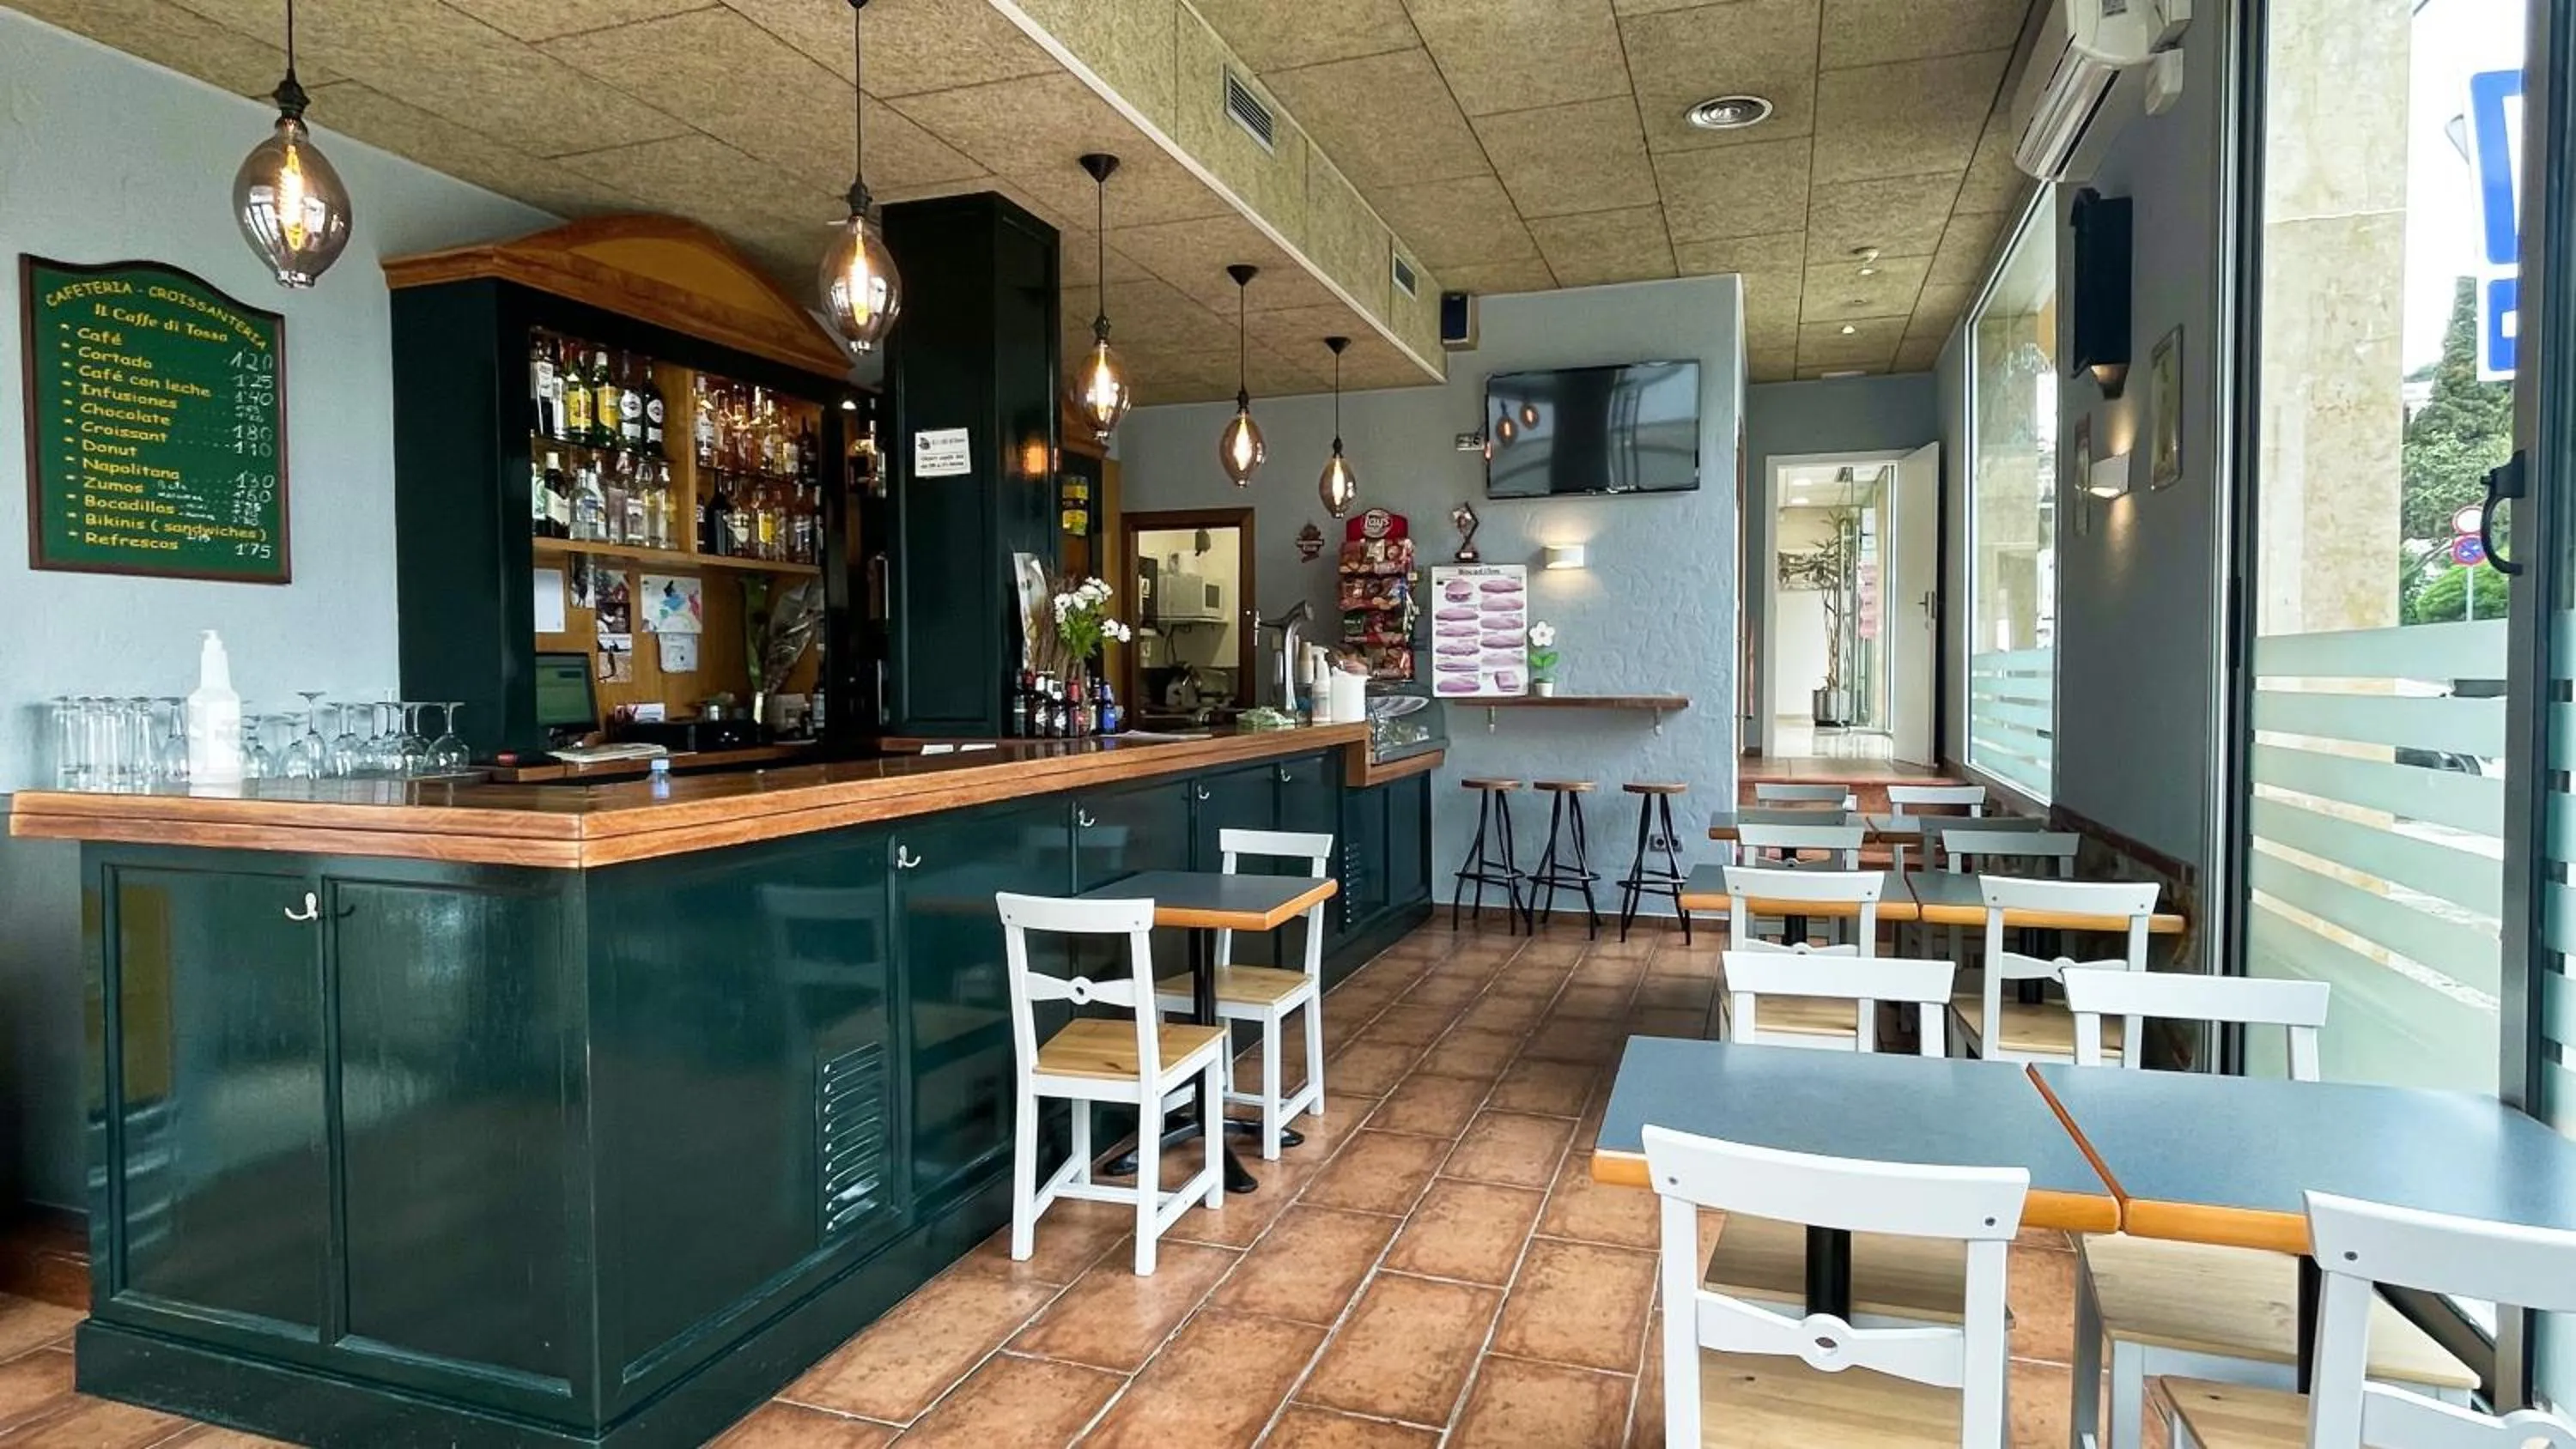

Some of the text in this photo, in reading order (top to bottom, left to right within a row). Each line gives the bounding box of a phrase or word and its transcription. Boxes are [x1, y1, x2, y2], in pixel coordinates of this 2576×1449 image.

[46, 281, 132, 306] CAFETERIA
[149, 286, 266, 350] CROISSANTERIA
[164, 319, 179, 332] di
[76, 327, 122, 345] Café
[78, 346, 153, 369] Cortado
[78, 365, 124, 382] Café
[130, 376, 160, 389] con
[166, 379, 212, 398] leche
[80, 383, 178, 409] Infusiones
[81, 403, 172, 426] Chocolate
[82, 421, 167, 444] Croissant
[82, 439, 137, 458] Donut
[83, 458, 179, 481] Napolitana
[83, 476, 144, 494] Zumos
[84, 494, 176, 515] Bocadillos
[85, 512, 146, 530] Bikinis
[85, 531, 179, 550] Refrescos
